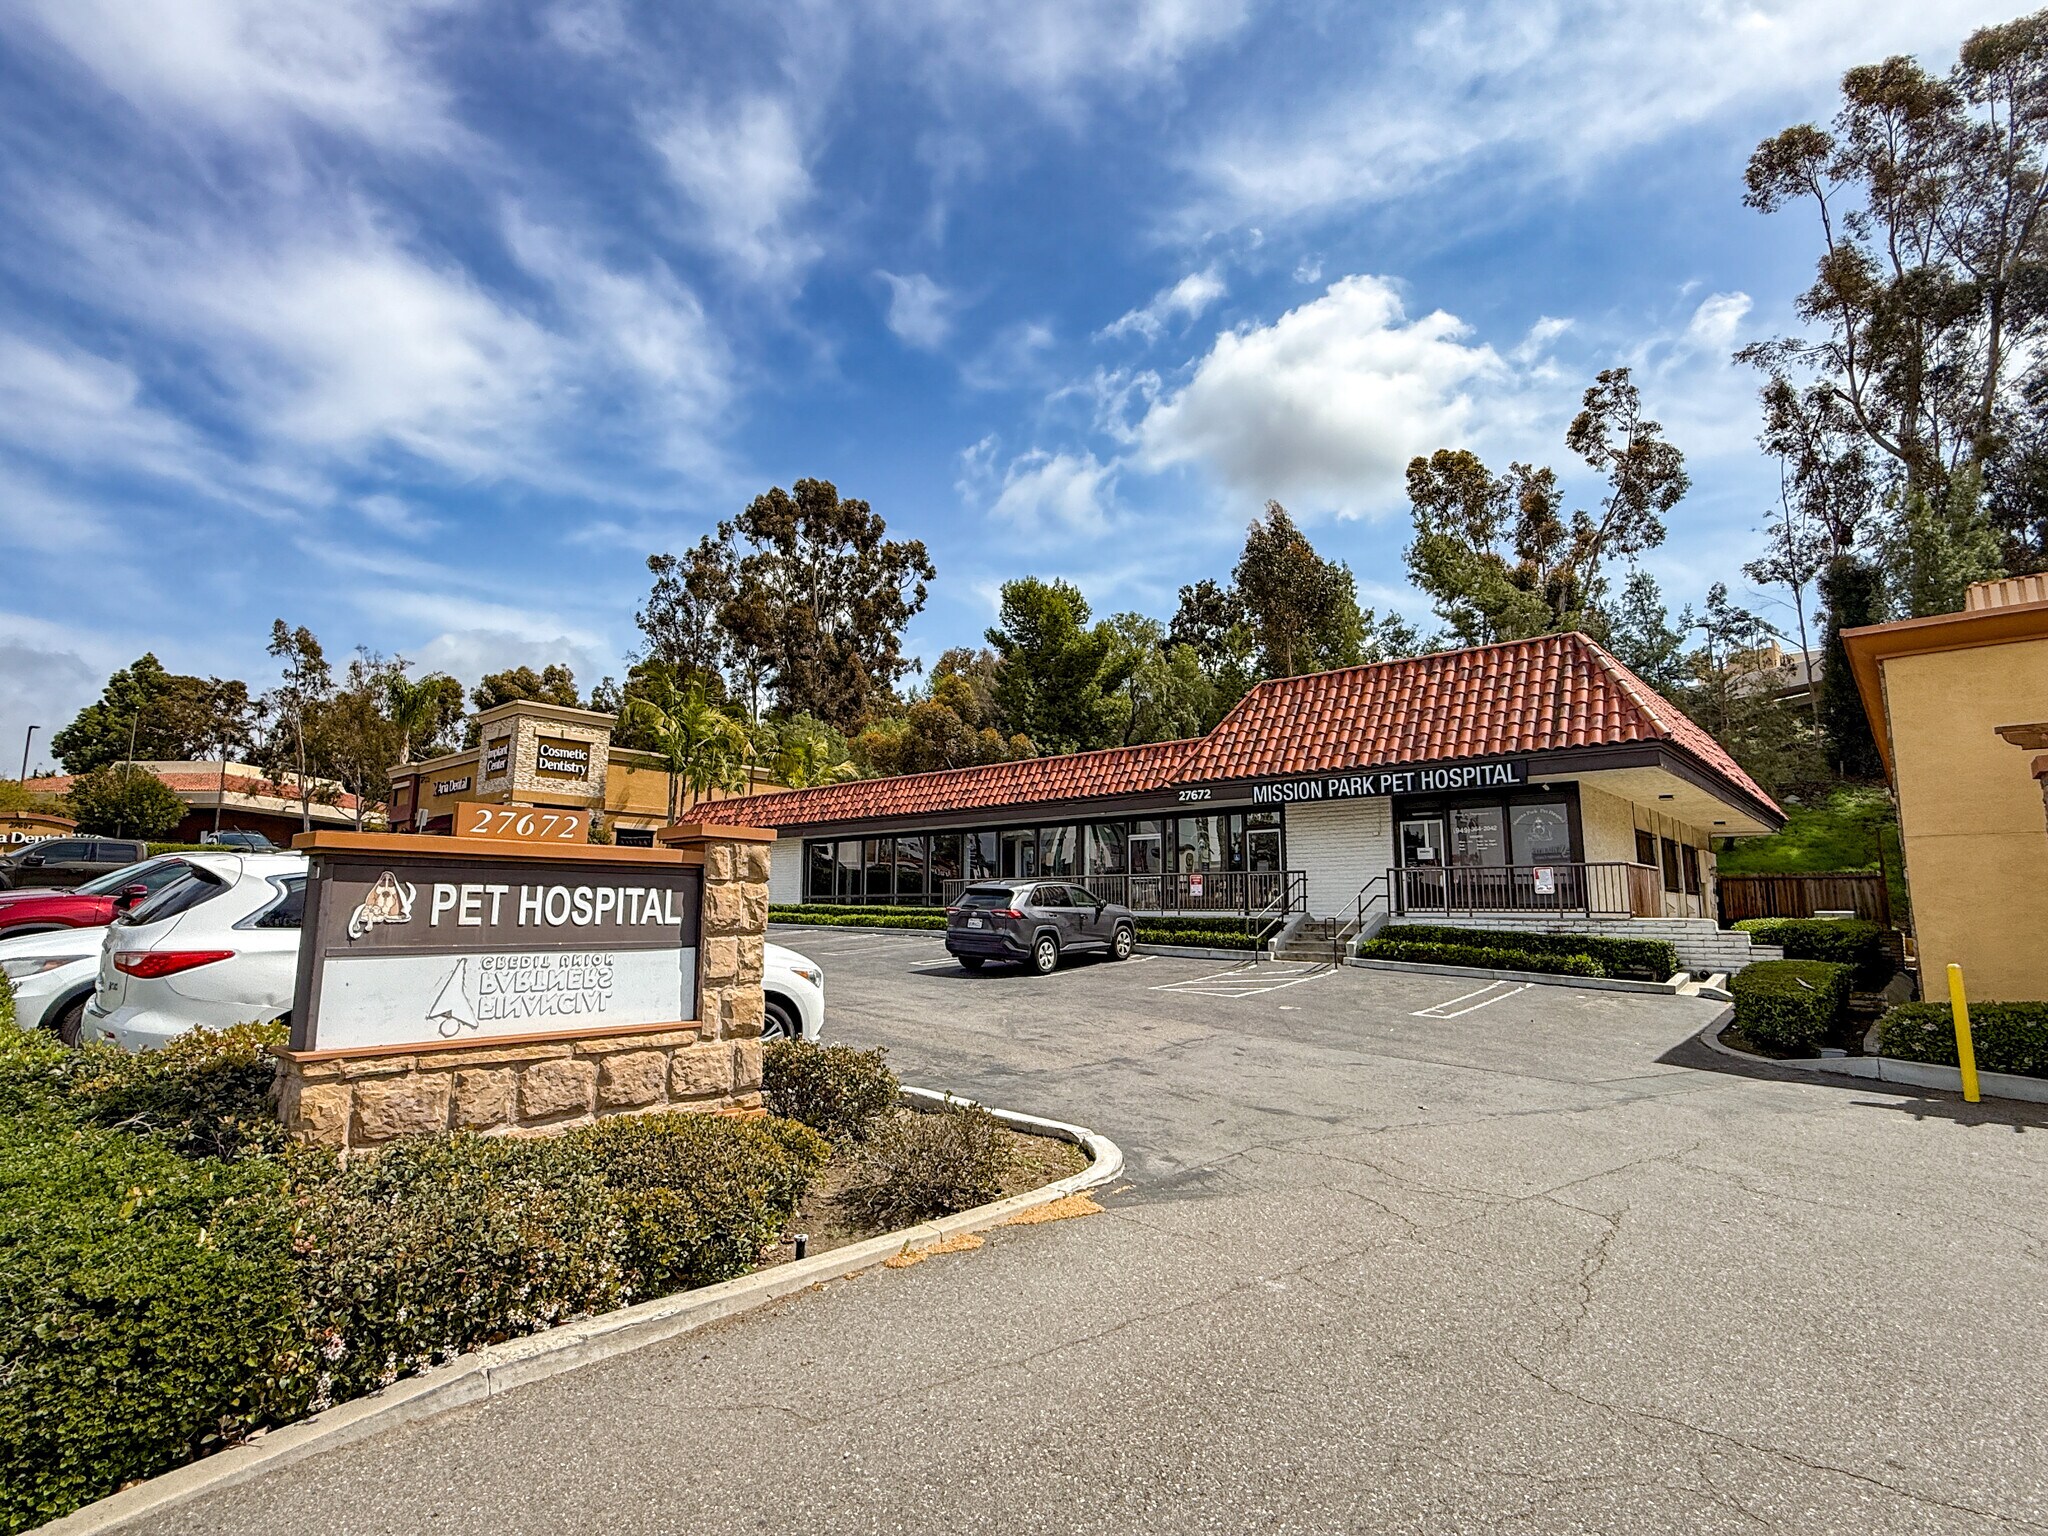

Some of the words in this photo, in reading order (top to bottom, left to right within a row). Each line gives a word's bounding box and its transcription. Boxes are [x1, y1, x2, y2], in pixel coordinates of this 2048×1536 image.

[487, 745, 508, 759] Implant
[540, 744, 588, 761] Cosmetic
[487, 760, 507, 772] Center
[538, 757, 588, 776] Dentistry
[449, 776, 468, 792] Dental
[1253, 780, 1323, 803] MISSION
[1328, 776, 1376, 798] PARK
[1380, 772, 1415, 793] PET
[1421, 763, 1521, 790] HOSPITAL
[1178, 789, 1212, 801] 27672
[469, 809, 579, 839] 27672
[430, 883, 509, 927] PET
[518, 885, 682, 926] HOSPITAL
